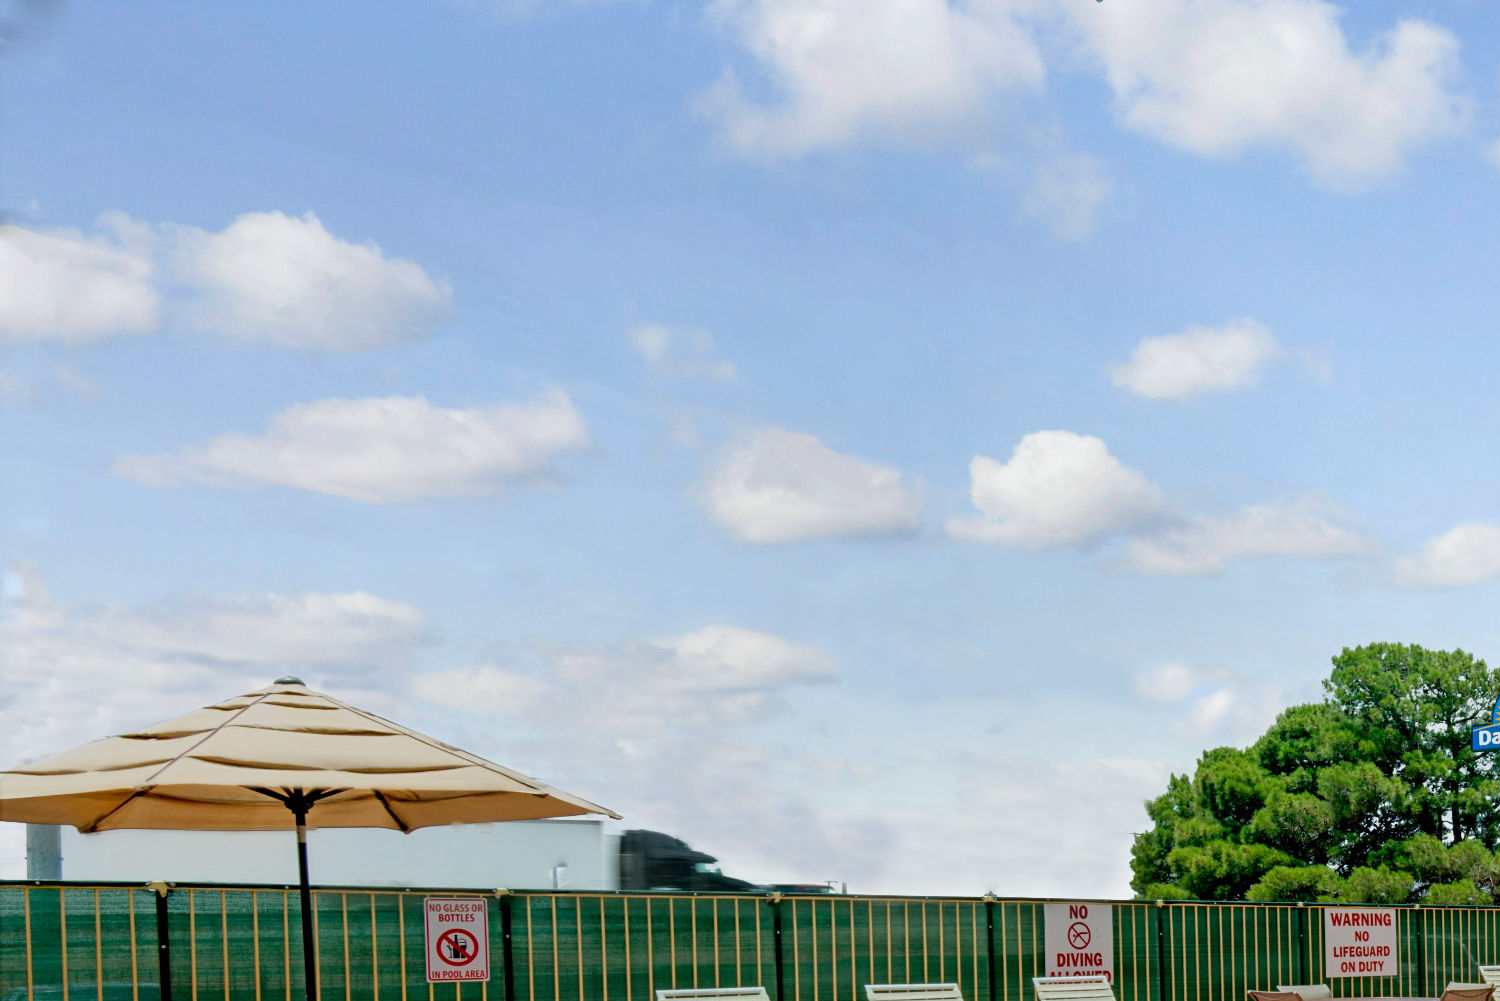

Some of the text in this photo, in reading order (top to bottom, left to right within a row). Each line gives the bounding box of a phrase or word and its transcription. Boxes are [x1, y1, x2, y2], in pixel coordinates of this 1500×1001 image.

[429, 903, 483, 912] NO GLASS OR
[1069, 905, 1088, 919] NO
[438, 913, 475, 922] BOTTLES
[1330, 912, 1391, 926] WARNING
[1355, 930, 1369, 942] NO
[1333, 945, 1390, 957] LIFEGUARD
[1056, 952, 1103, 967] DIVING
[1340, 961, 1384, 973] ON DUTY
[431, 970, 440, 978] IN
[442, 970, 463, 978] POOL
